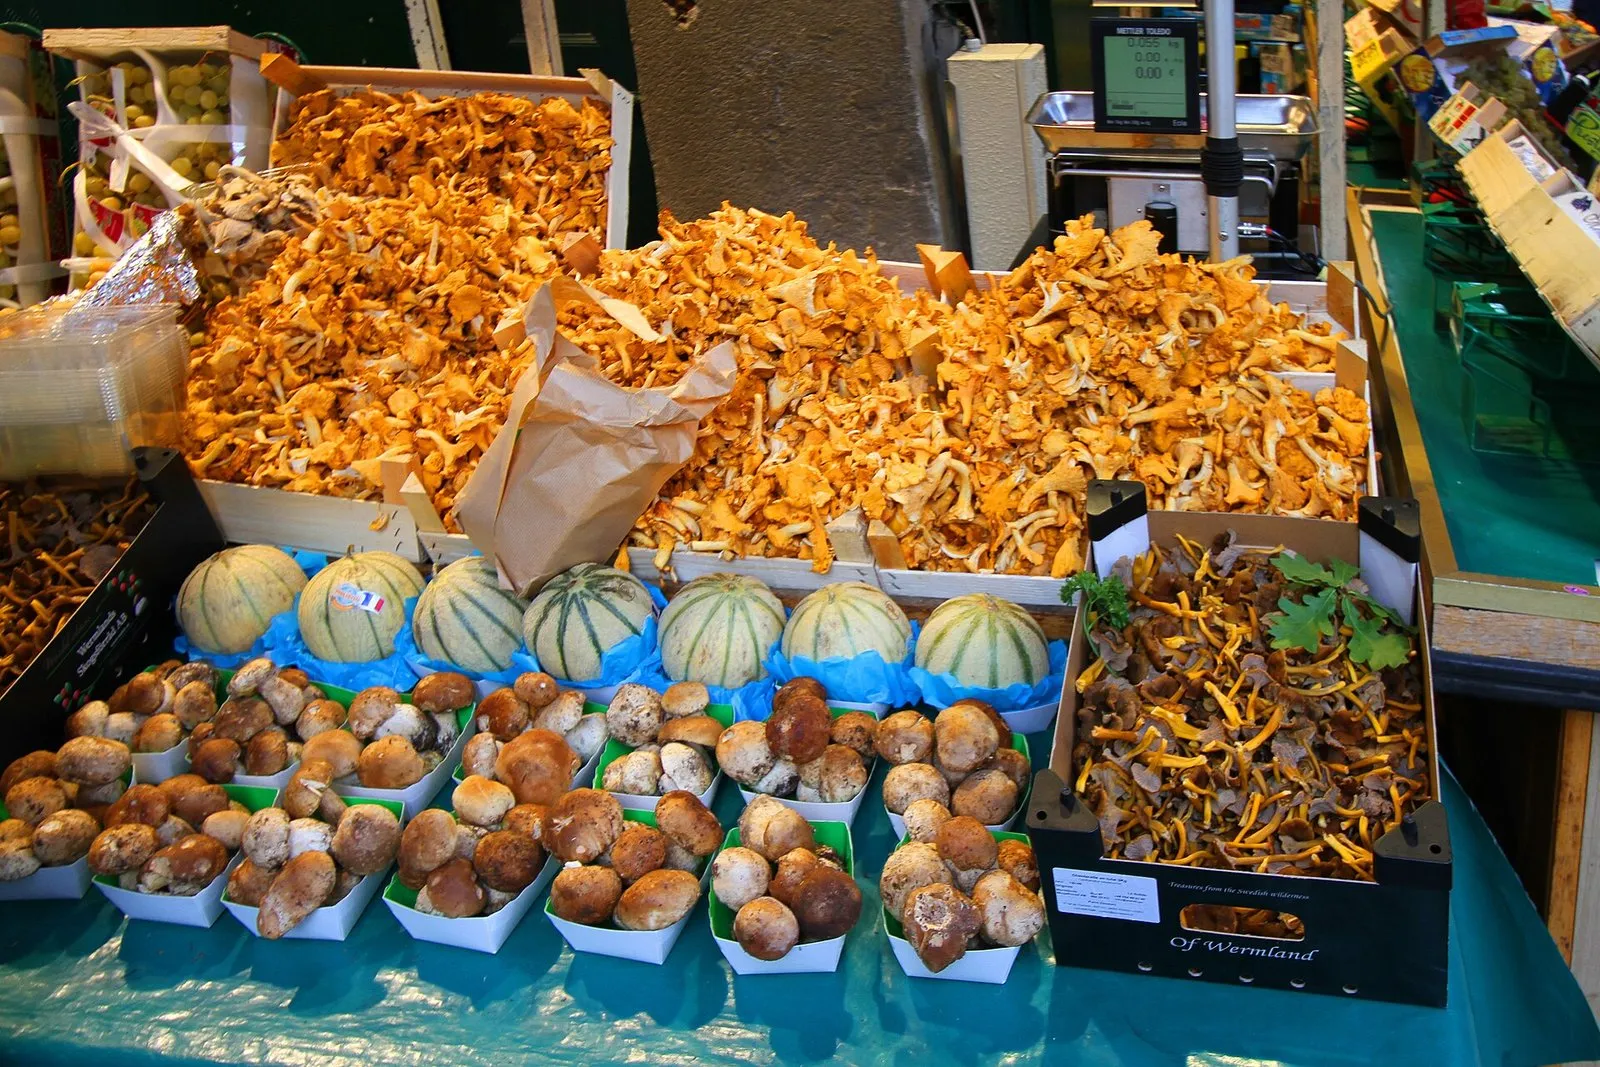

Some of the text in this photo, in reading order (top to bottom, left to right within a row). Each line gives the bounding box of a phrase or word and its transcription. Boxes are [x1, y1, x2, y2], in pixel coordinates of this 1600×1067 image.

[1136, 67, 1161, 79] 0.00
[1168, 881, 1310, 900] Treasures from the Swedish wilderness
[1169, 936, 1320, 962] Of Wermland
